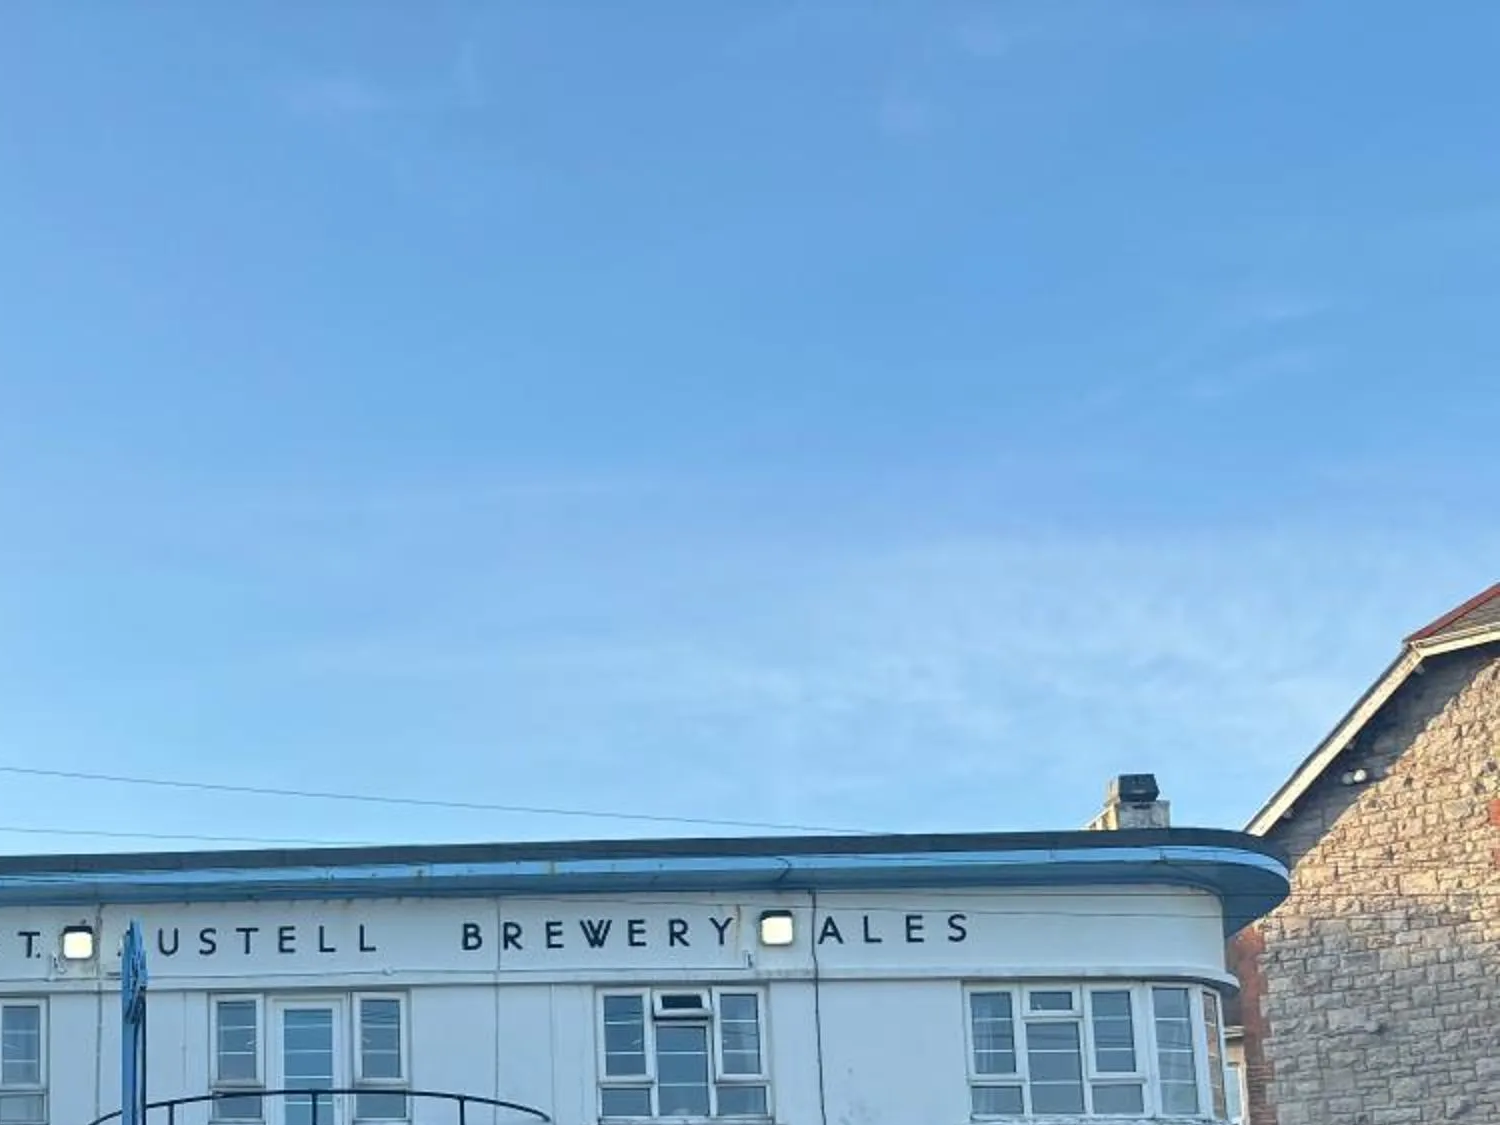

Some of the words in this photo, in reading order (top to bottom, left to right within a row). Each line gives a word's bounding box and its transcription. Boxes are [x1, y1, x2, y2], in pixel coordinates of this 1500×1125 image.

[116, 925, 377, 957] USTELL
[462, 917, 734, 951] BREWERY
[818, 913, 967, 945] ALES
